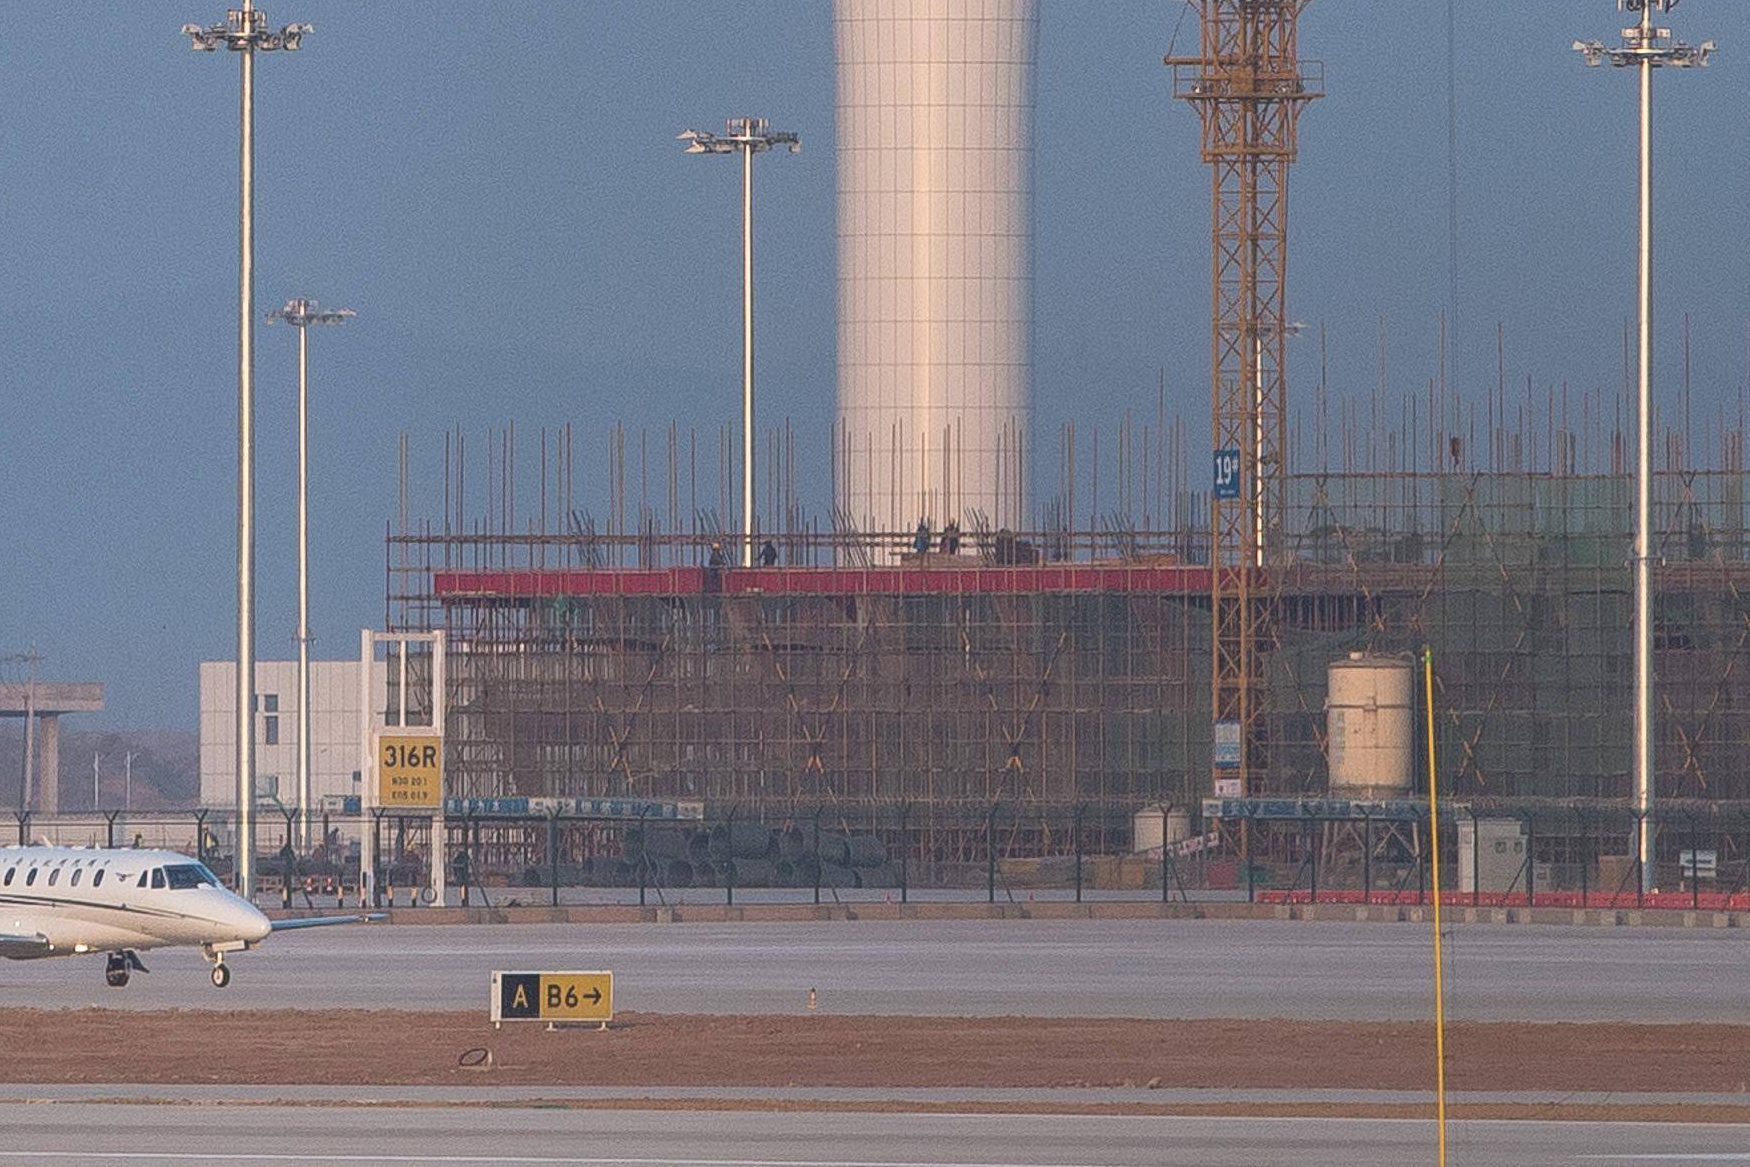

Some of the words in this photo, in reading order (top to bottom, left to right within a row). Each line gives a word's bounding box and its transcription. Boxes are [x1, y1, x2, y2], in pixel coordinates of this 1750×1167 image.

[384, 745, 437, 768] 316R
[512, 983, 529, 1009] A
[547, 984, 579, 1008] B6
